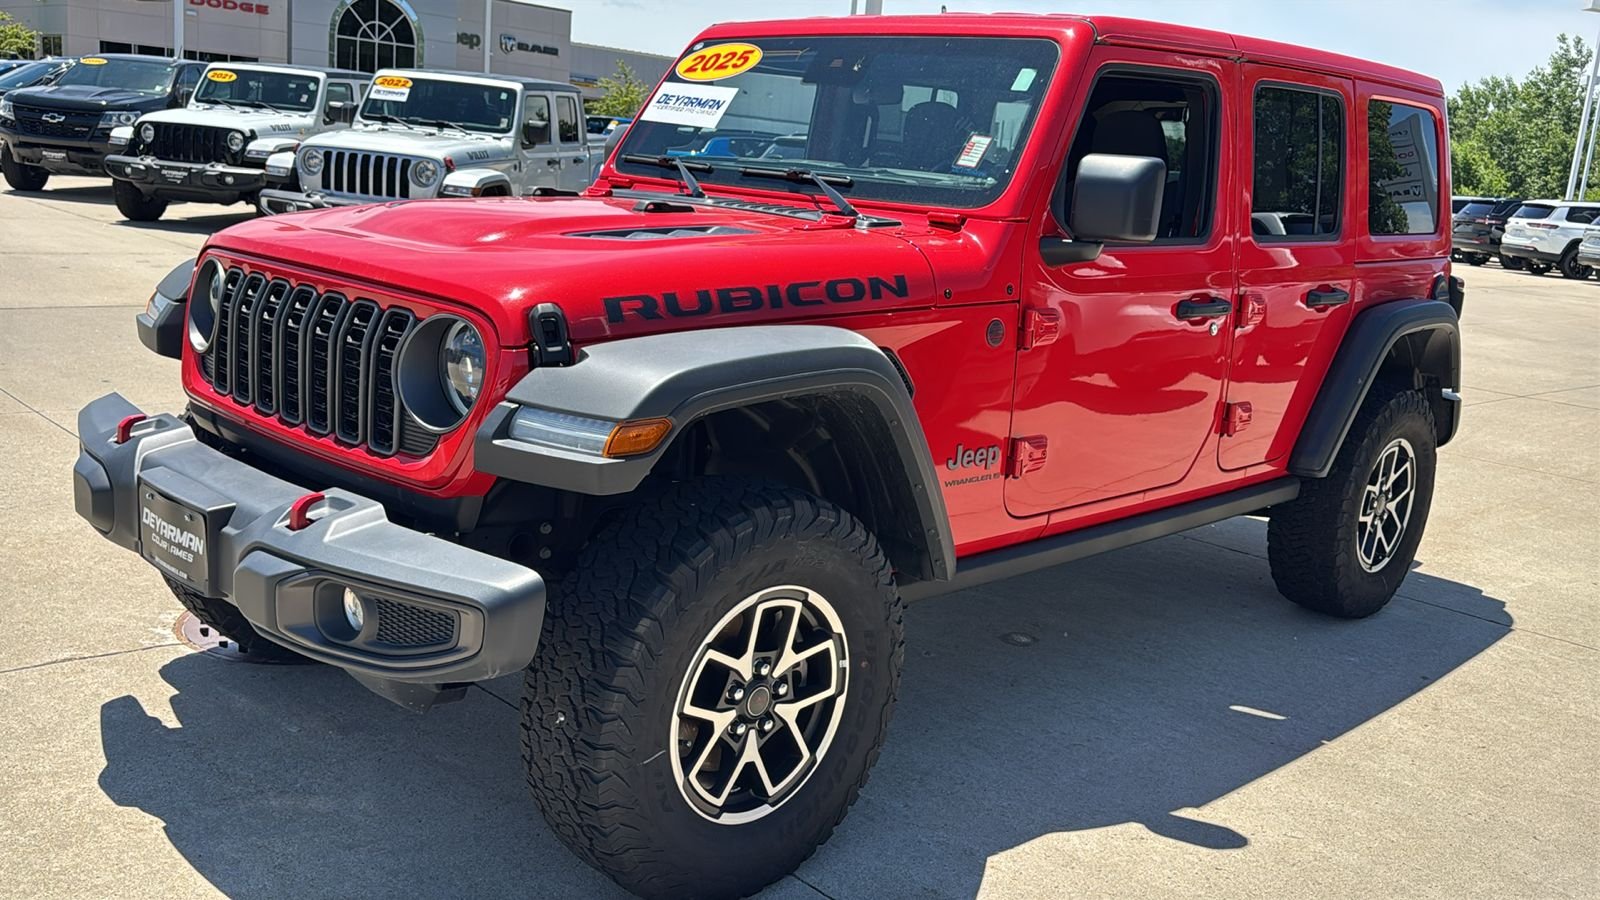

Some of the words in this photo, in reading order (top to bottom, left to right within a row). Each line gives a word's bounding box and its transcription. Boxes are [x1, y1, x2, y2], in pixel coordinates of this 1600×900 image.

[683, 50, 755, 73] 2025
[211, 72, 233, 80] 2021
[379, 78, 409, 87] 2022
[656, 93, 726, 110] DEYARMAN
[604, 275, 909, 324] RUBICON
[947, 443, 1001, 470] Jeep
[945, 474, 992, 487] WRANGLER
[143, 508, 203, 555] DEYARMAN
[170, 545, 194, 563] AMES
